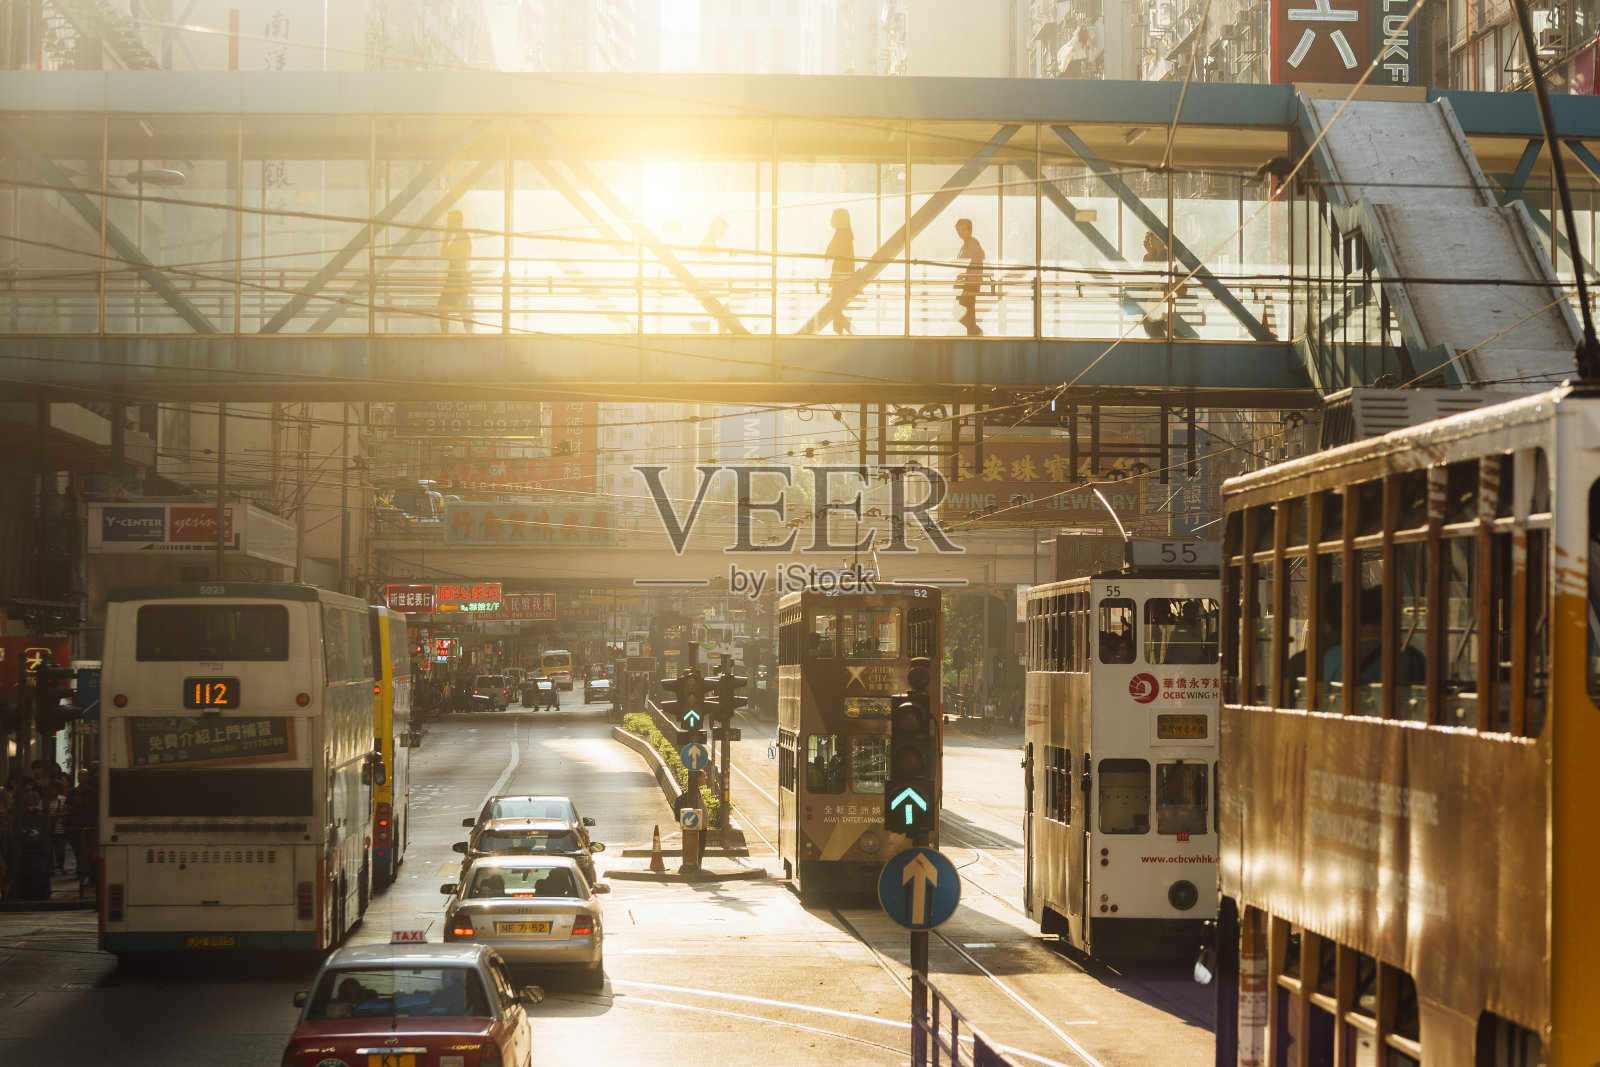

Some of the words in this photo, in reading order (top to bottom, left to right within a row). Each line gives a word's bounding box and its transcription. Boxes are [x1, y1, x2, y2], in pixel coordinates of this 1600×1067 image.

[456, 402, 486, 411] Credit
[947, 493, 997, 510] WING
[106, 516, 163, 527] Y-CENTER
[1161, 543, 1198, 563] 55
[200, 586, 226, 595] 5023
[437, 584, 500, 601] 頂尖球衣
[913, 589, 928, 599] 52
[1106, 585, 1121, 597] 55
[195, 683, 228, 704] 112
[1162, 691, 1186, 699] OCBC
[1186, 691, 1210, 699] WING
[149, 720, 272, 751] 免費介紹上門補習
[501, 924, 515, 933] NE
[393, 930, 424, 941] TAXI
[381, 1054, 401, 1067] KT
